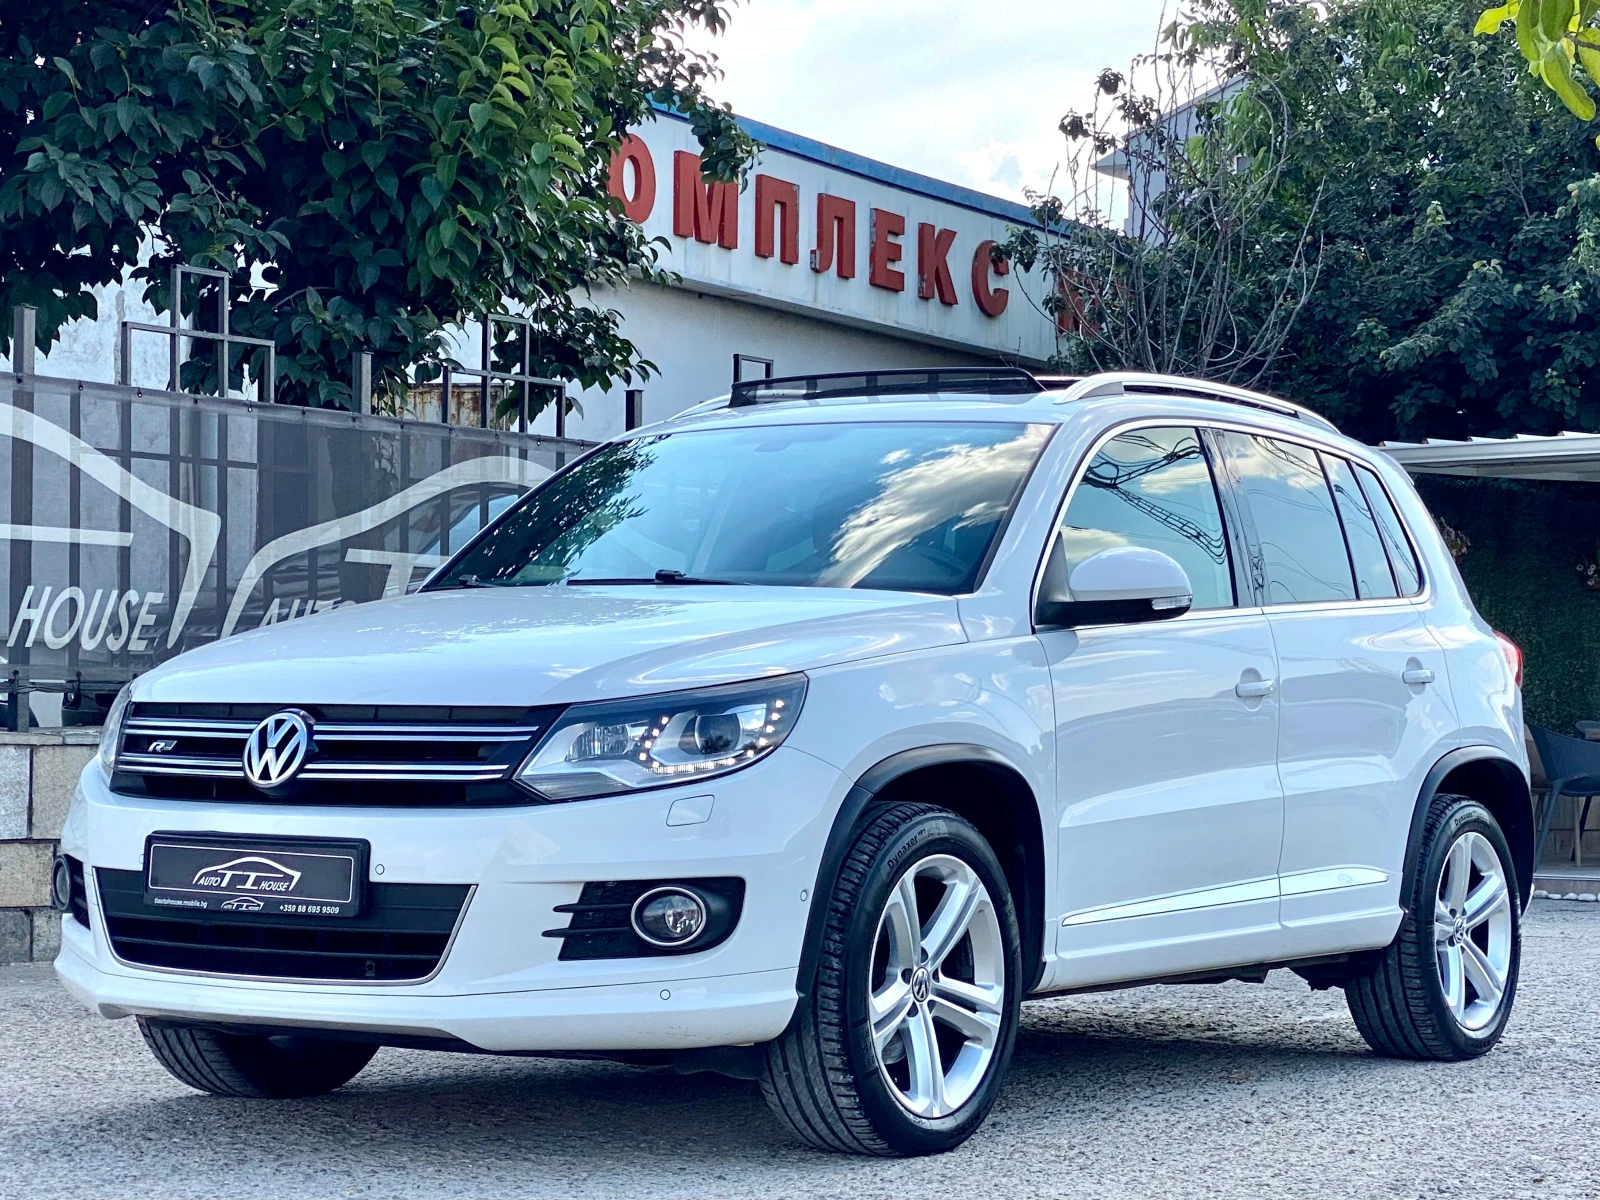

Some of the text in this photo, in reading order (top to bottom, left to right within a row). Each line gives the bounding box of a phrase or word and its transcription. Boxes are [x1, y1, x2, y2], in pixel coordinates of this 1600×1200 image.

[6, 585, 164, 651] HOUSE
[887, 834, 918, 869] Dynaxer
[198, 876, 220, 887] AUTO
[259, 880, 290, 892] HOUSE
[279, 904, 340, 914] +359 88 695 9509
